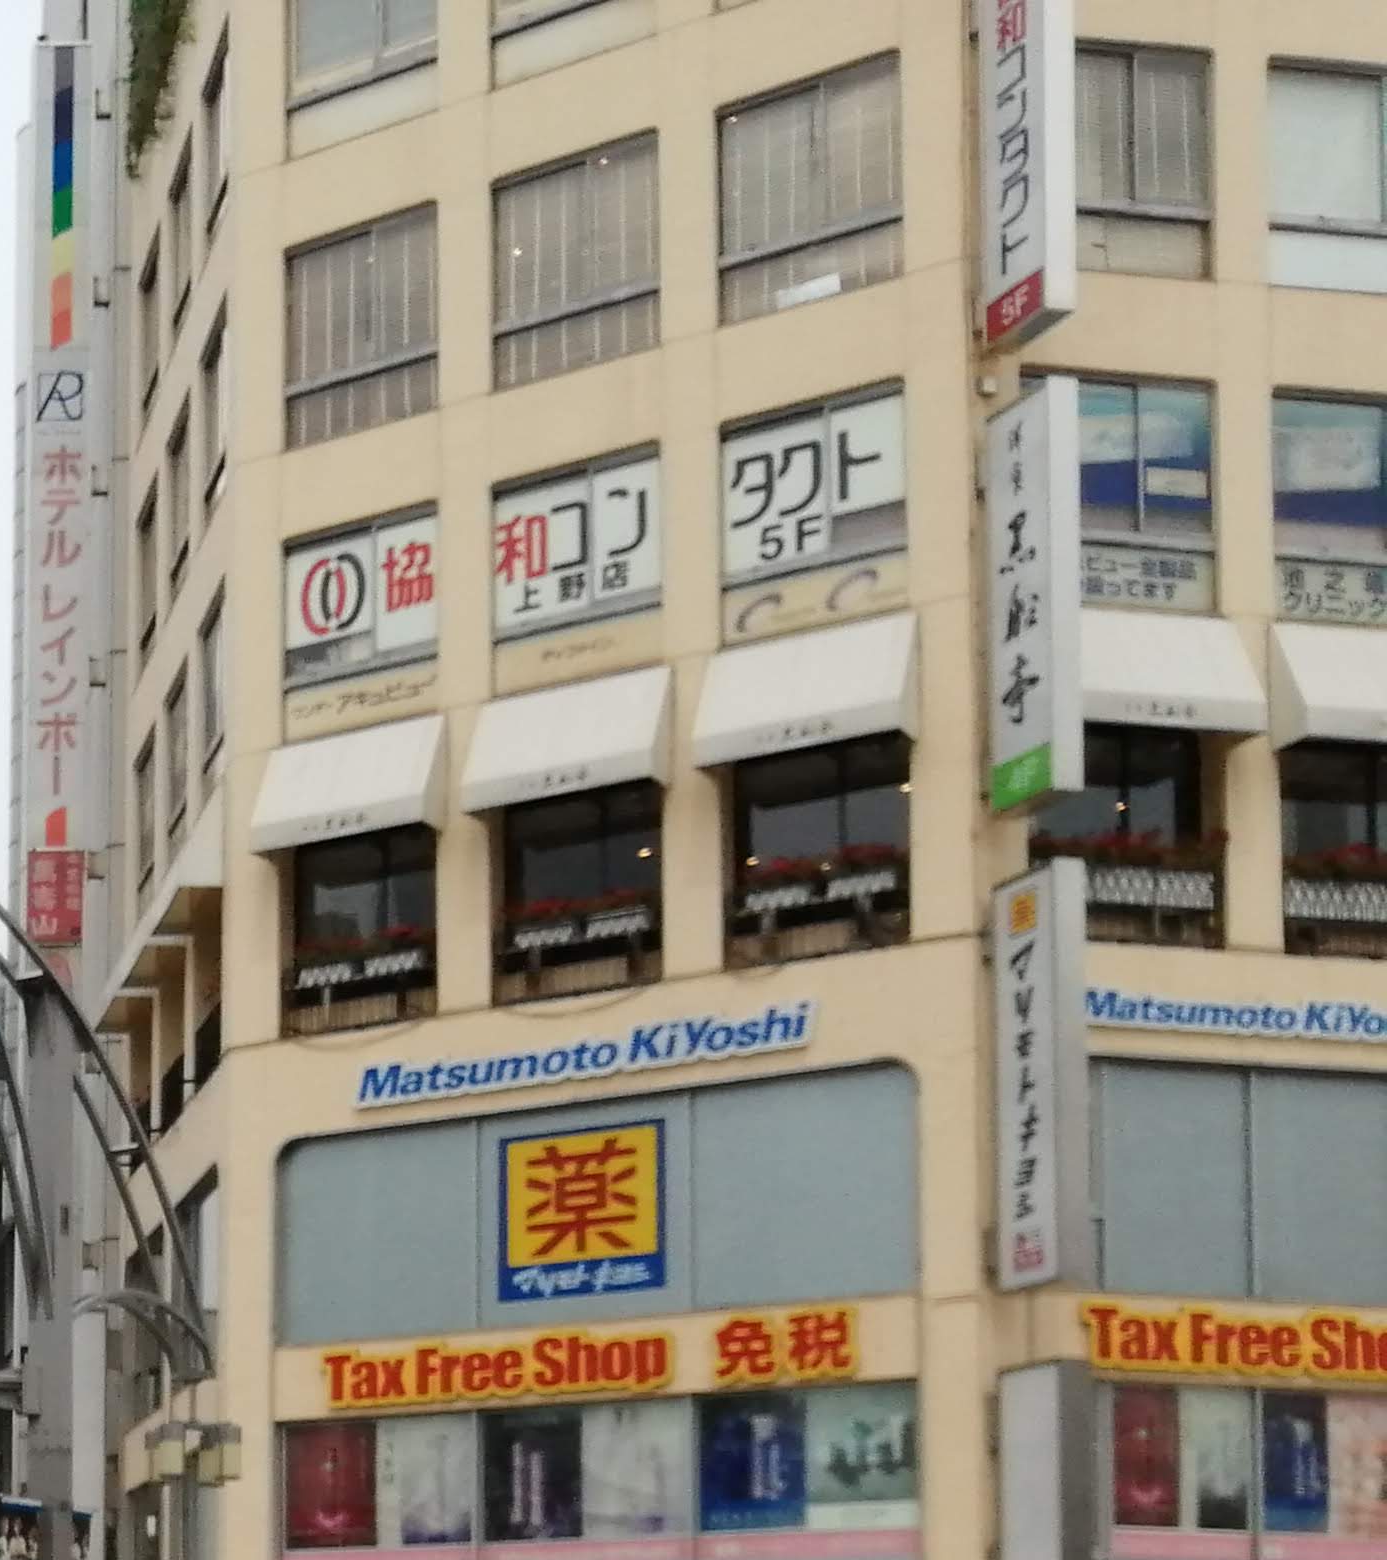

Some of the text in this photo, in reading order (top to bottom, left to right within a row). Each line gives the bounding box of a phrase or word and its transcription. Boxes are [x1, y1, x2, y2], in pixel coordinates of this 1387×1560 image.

[996, 0, 1029, 276] 和コンタクト
[1000, 284, 1030, 327] 5F
[760, 513, 823, 560] 5F
[513, 559, 632, 614] 上野店
[1080, 577, 1177, 601] 扱ってます
[36, 443, 83, 796] ホテルレインボー
[1085, 989, 1297, 1030] Matsumoto
[357, 1003, 812, 1102] Matsumoto KiYoshi
[525, 1137, 637, 1258] 薬
[325, 1335, 669, 1402] Tax Free Shop
[714, 1310, 852, 1380] 免税
[1089, 1307, 1179, 1361] Tax
[1189, 1312, 1302, 1368] Free
